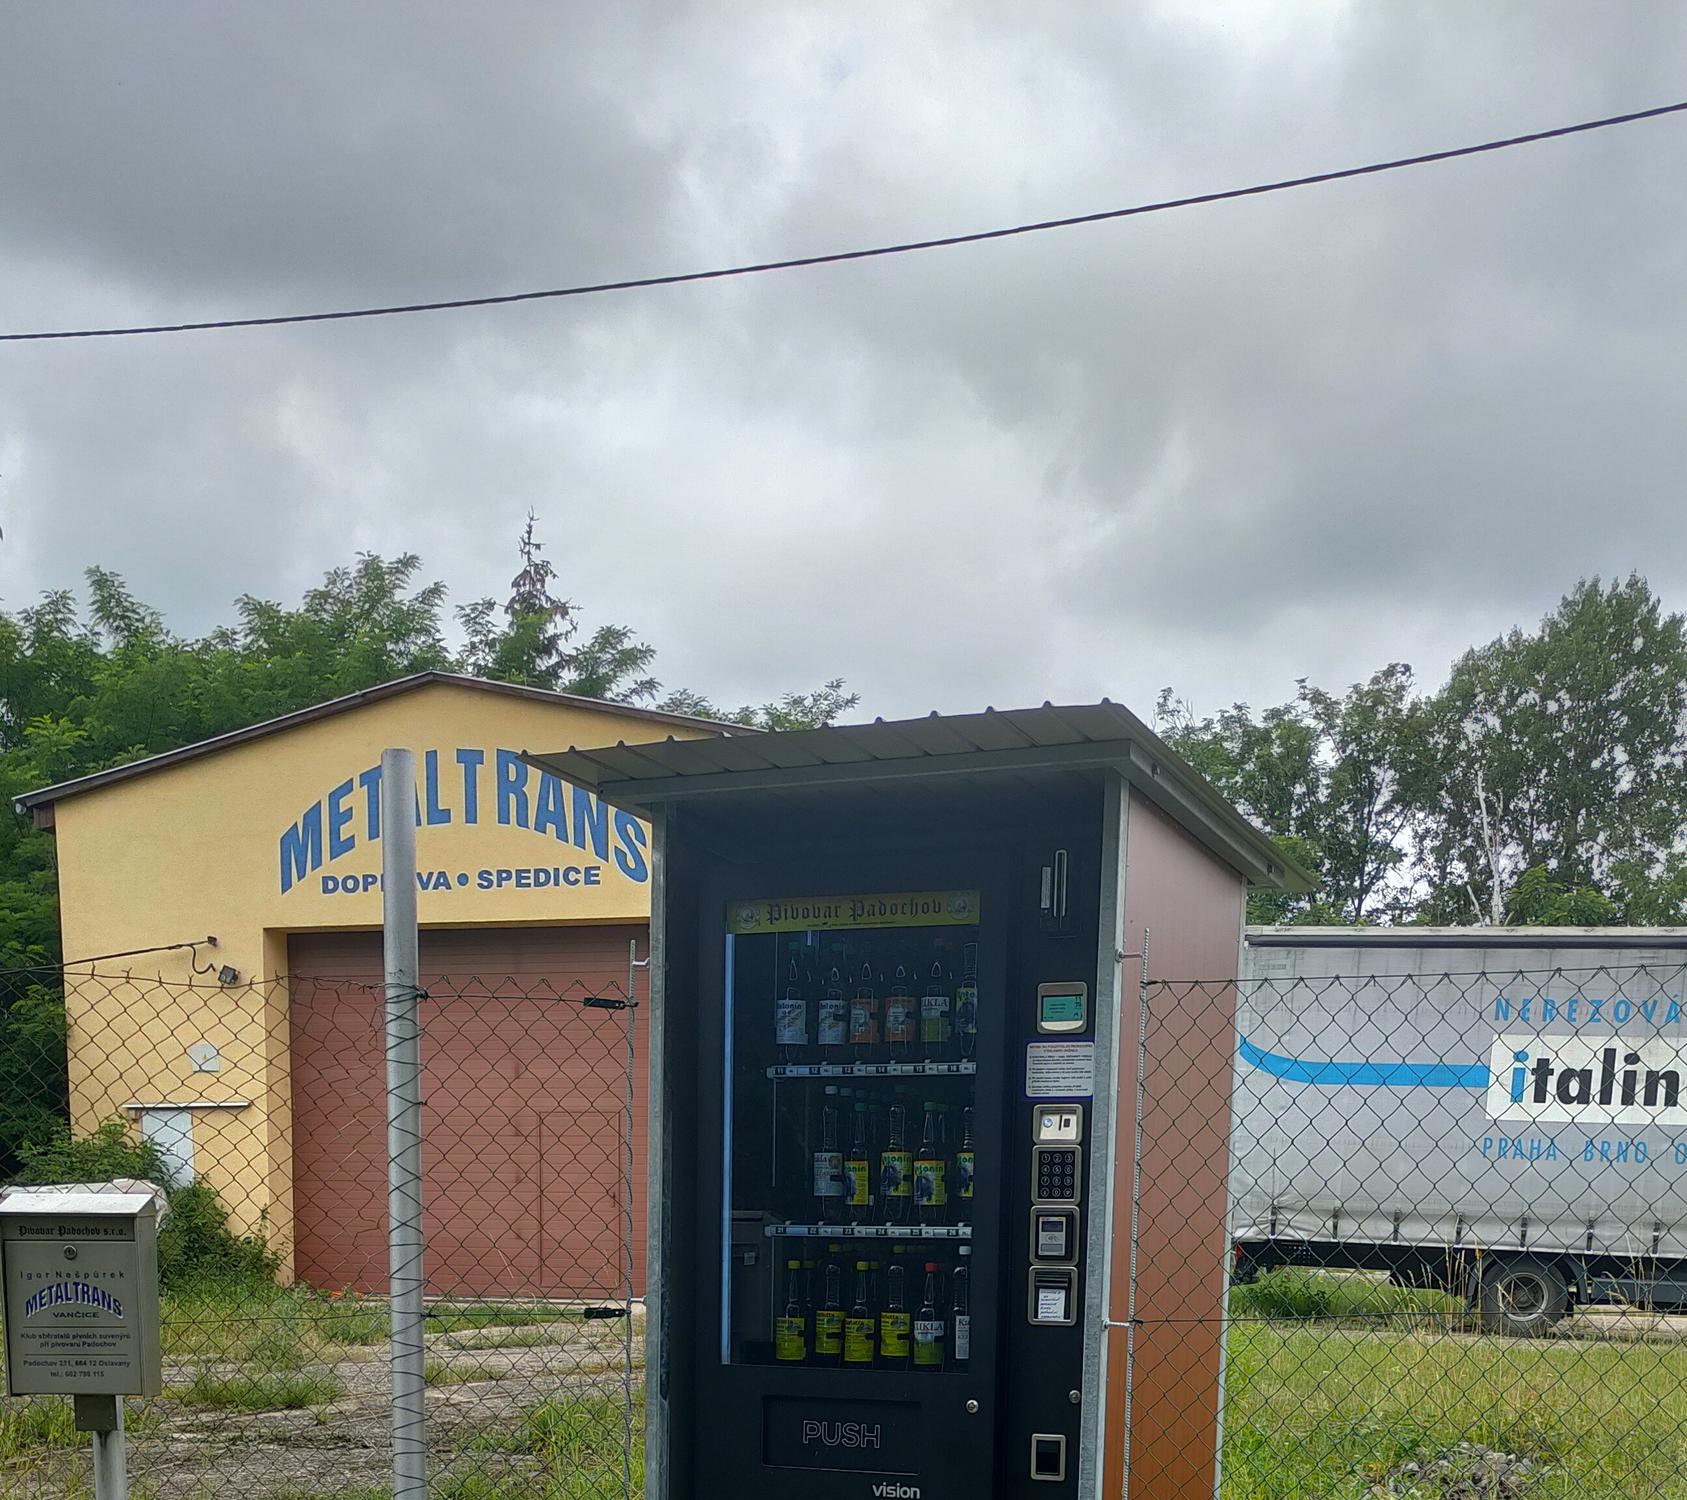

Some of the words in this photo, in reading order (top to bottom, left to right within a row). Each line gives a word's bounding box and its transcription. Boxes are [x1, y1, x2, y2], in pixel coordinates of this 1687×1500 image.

[280, 748, 648, 895] METLTRANS
[321, 871, 452, 894] DOPVA
[477, 865, 601, 889] SPEDICE
[766, 903, 841, 925] Pivovar
[848, 898, 942, 921] Padochov
[1494, 994, 1681, 1024] NEREZOVÁ
[1510, 1047, 1680, 1107] italin
[1482, 1137, 1558, 1161] PRAHA
[1583, 1139, 1647, 1164] BRNO
[18, 1225, 55, 1237] Pivovar
[58, 1225, 101, 1237] Padochov
[20, 1271, 50, 1280] Igor
[25, 1281, 124, 1319] METALTRANS
[802, 1419, 881, 1449] PUSH
[872, 1481, 921, 1500] vision
